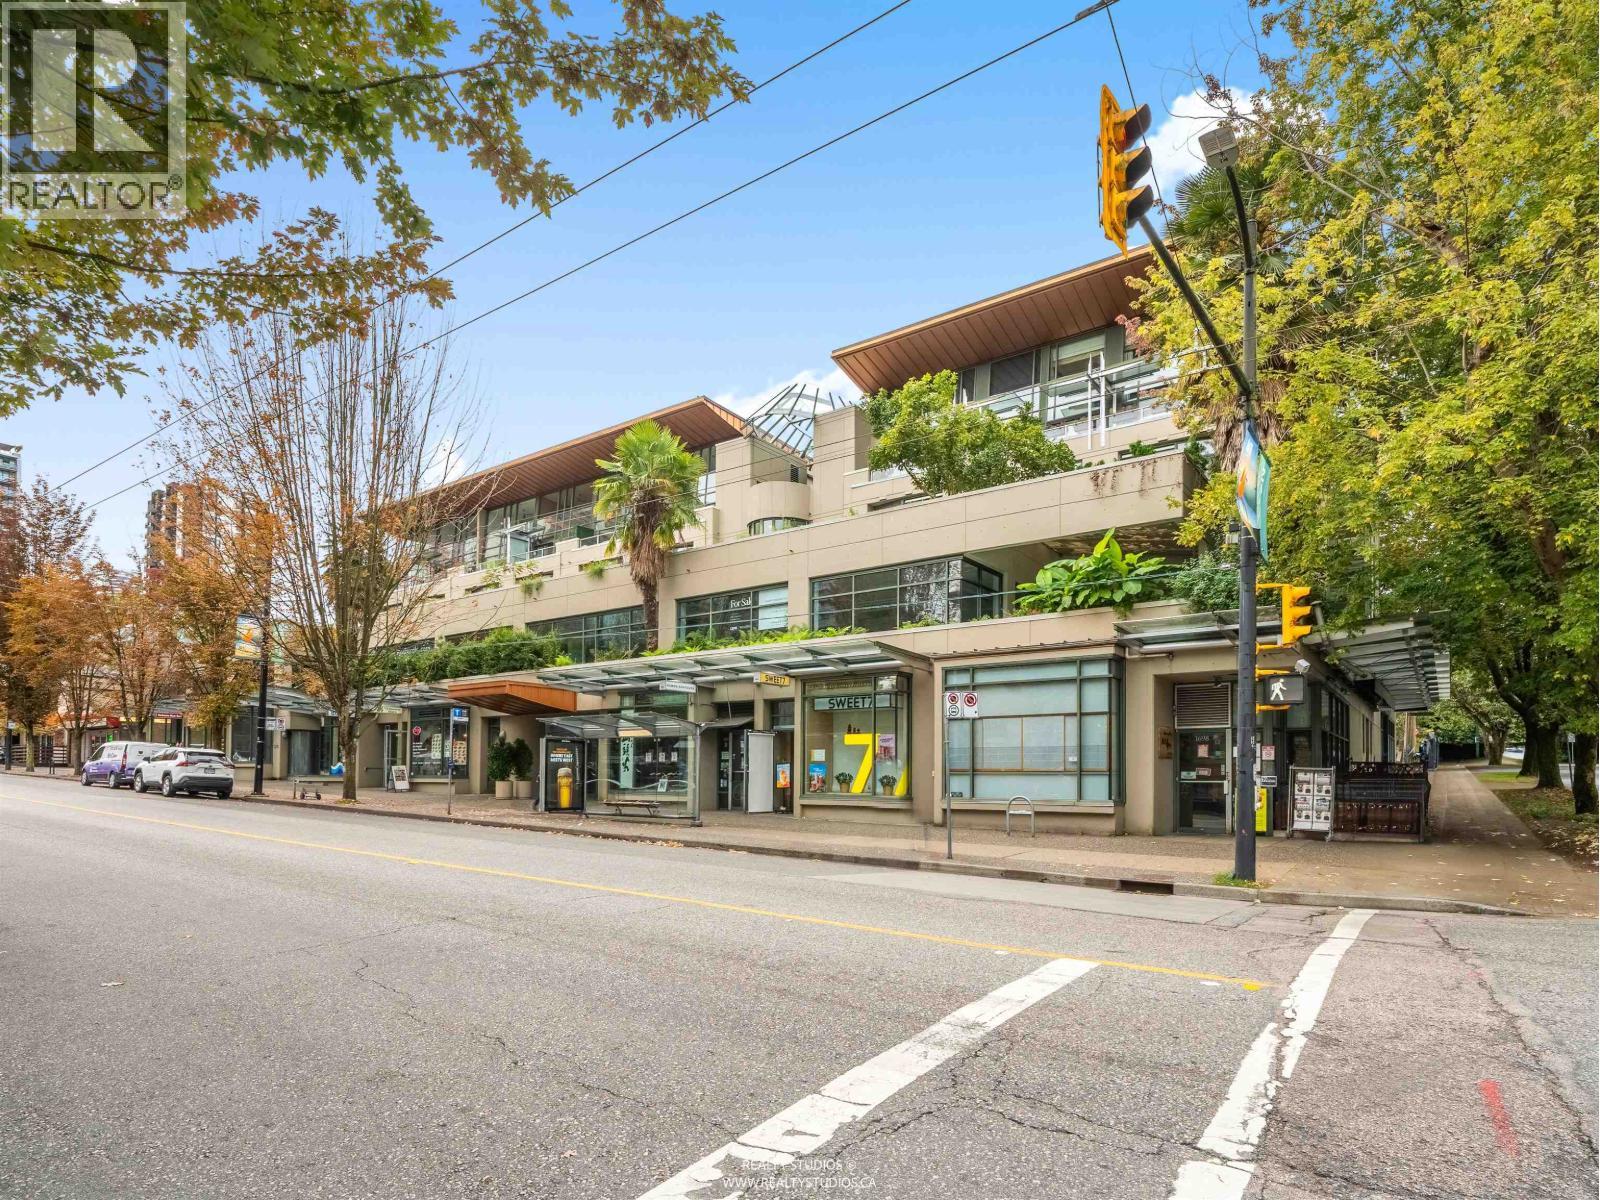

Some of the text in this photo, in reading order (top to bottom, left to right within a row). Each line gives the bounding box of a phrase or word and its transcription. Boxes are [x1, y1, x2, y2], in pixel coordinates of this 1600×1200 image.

[730, 599, 740, 608] For
[765, 674, 786, 685] SWEET7
[828, 696, 873, 709] SWEET7
[843, 732, 880, 794] 7
